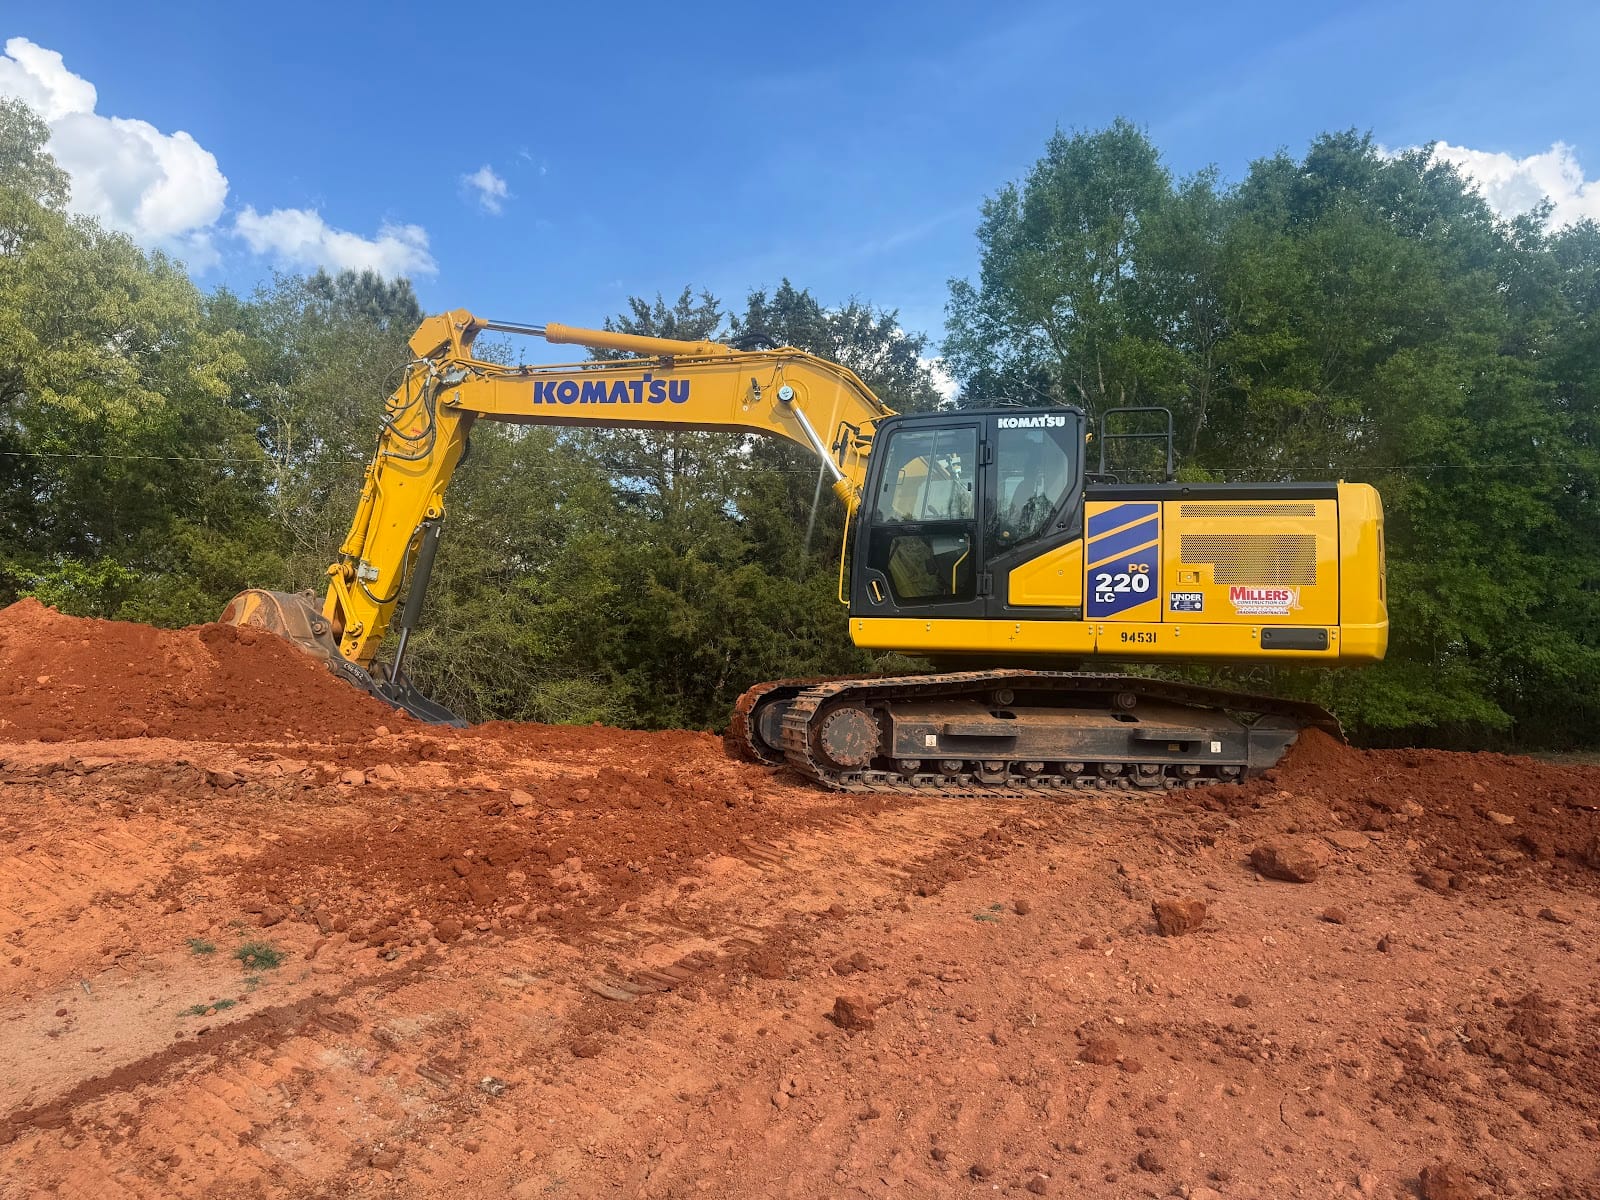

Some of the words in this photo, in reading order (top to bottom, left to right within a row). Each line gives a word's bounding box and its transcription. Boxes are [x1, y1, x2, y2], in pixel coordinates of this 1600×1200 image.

[533, 373, 690, 404] KOMATSU
[997, 414, 1066, 429] KOMATSU
[1128, 563, 1150, 574] PC
[1095, 573, 1150, 593] 220
[1095, 592, 1116, 603] LC
[1120, 631, 1157, 643] 94531
